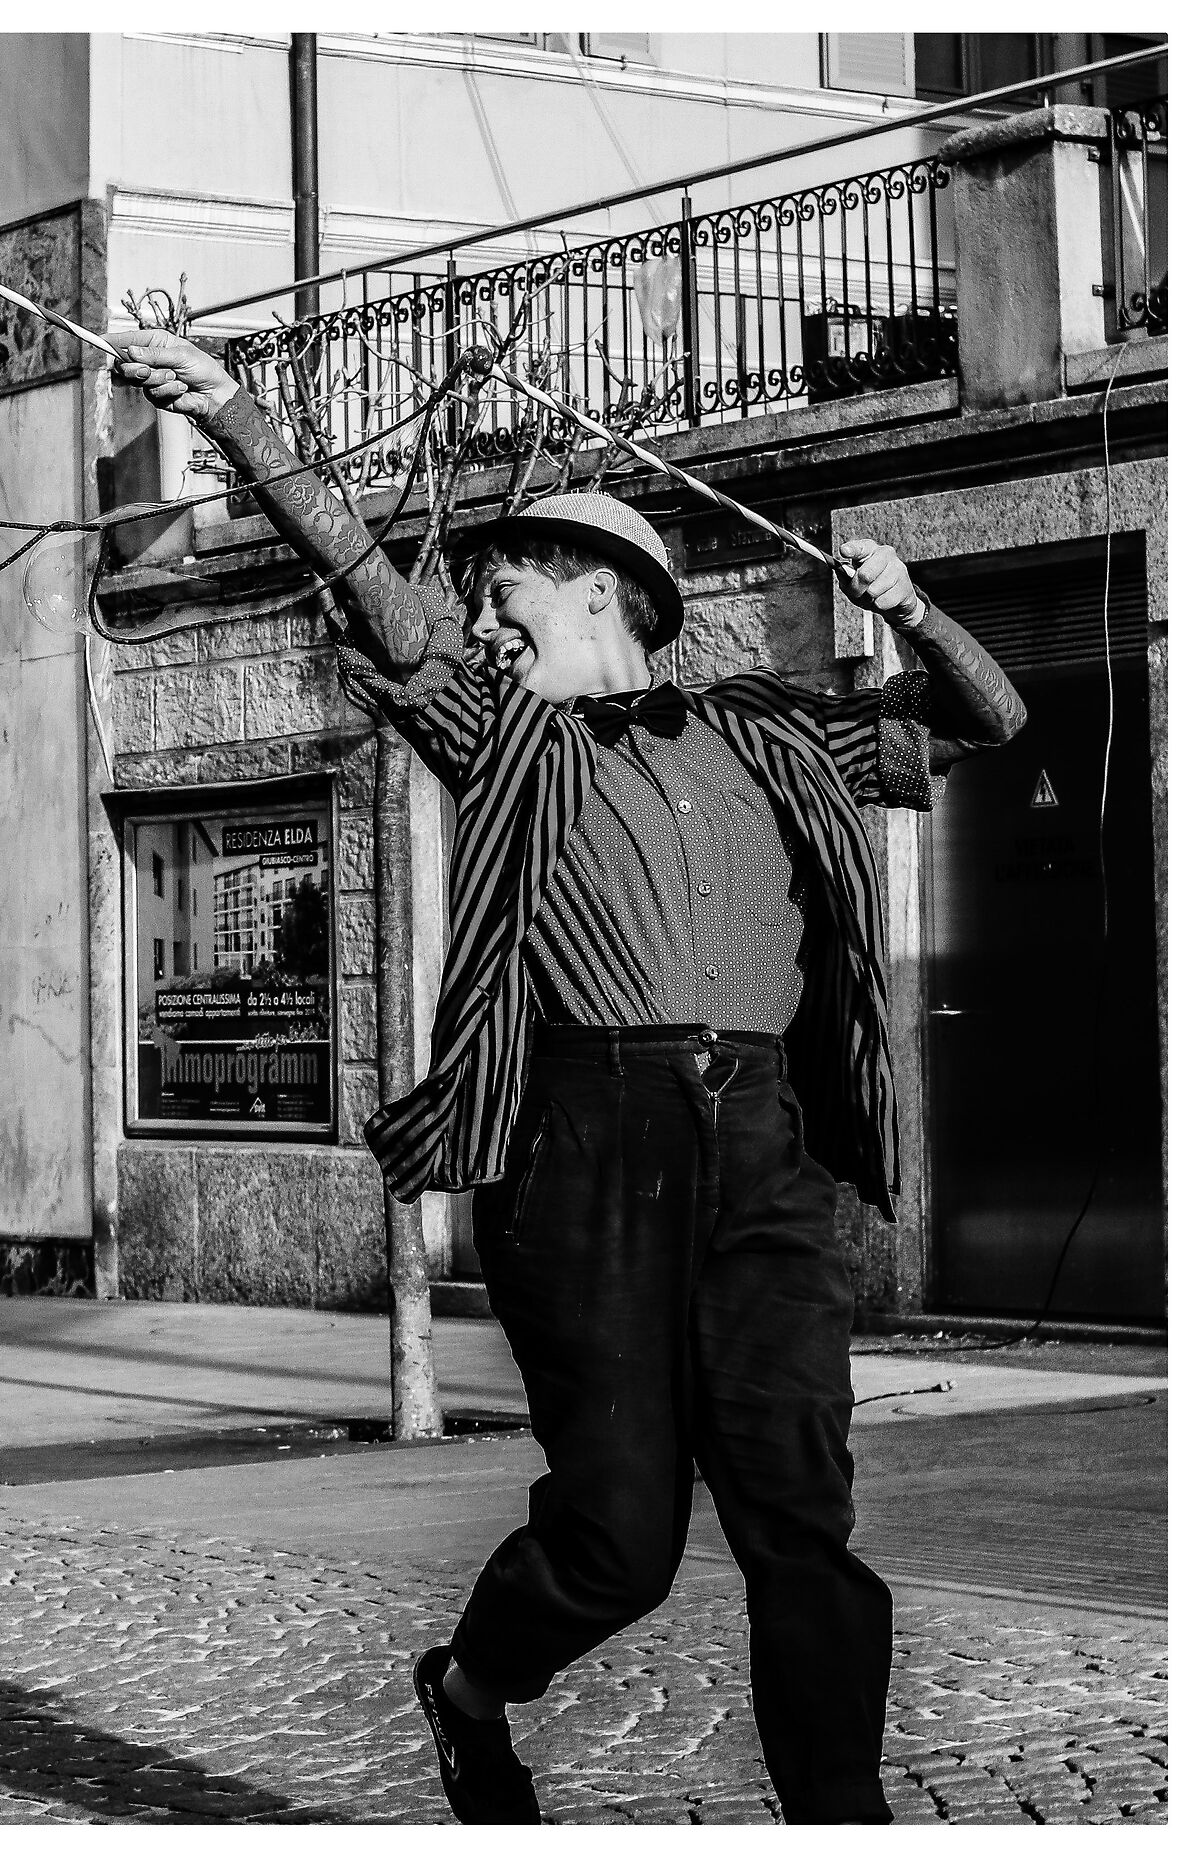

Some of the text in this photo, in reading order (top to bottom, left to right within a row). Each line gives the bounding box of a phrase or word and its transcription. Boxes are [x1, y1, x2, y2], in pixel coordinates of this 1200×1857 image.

[226, 827, 313, 849] RESIDENZA ELDA
[158, 993, 241, 1006] POSIZIONE CENTRALISSIMA
[247, 991, 258, 1006] da
[273, 996, 279, 1006] a
[295, 990, 315, 1005] locali
